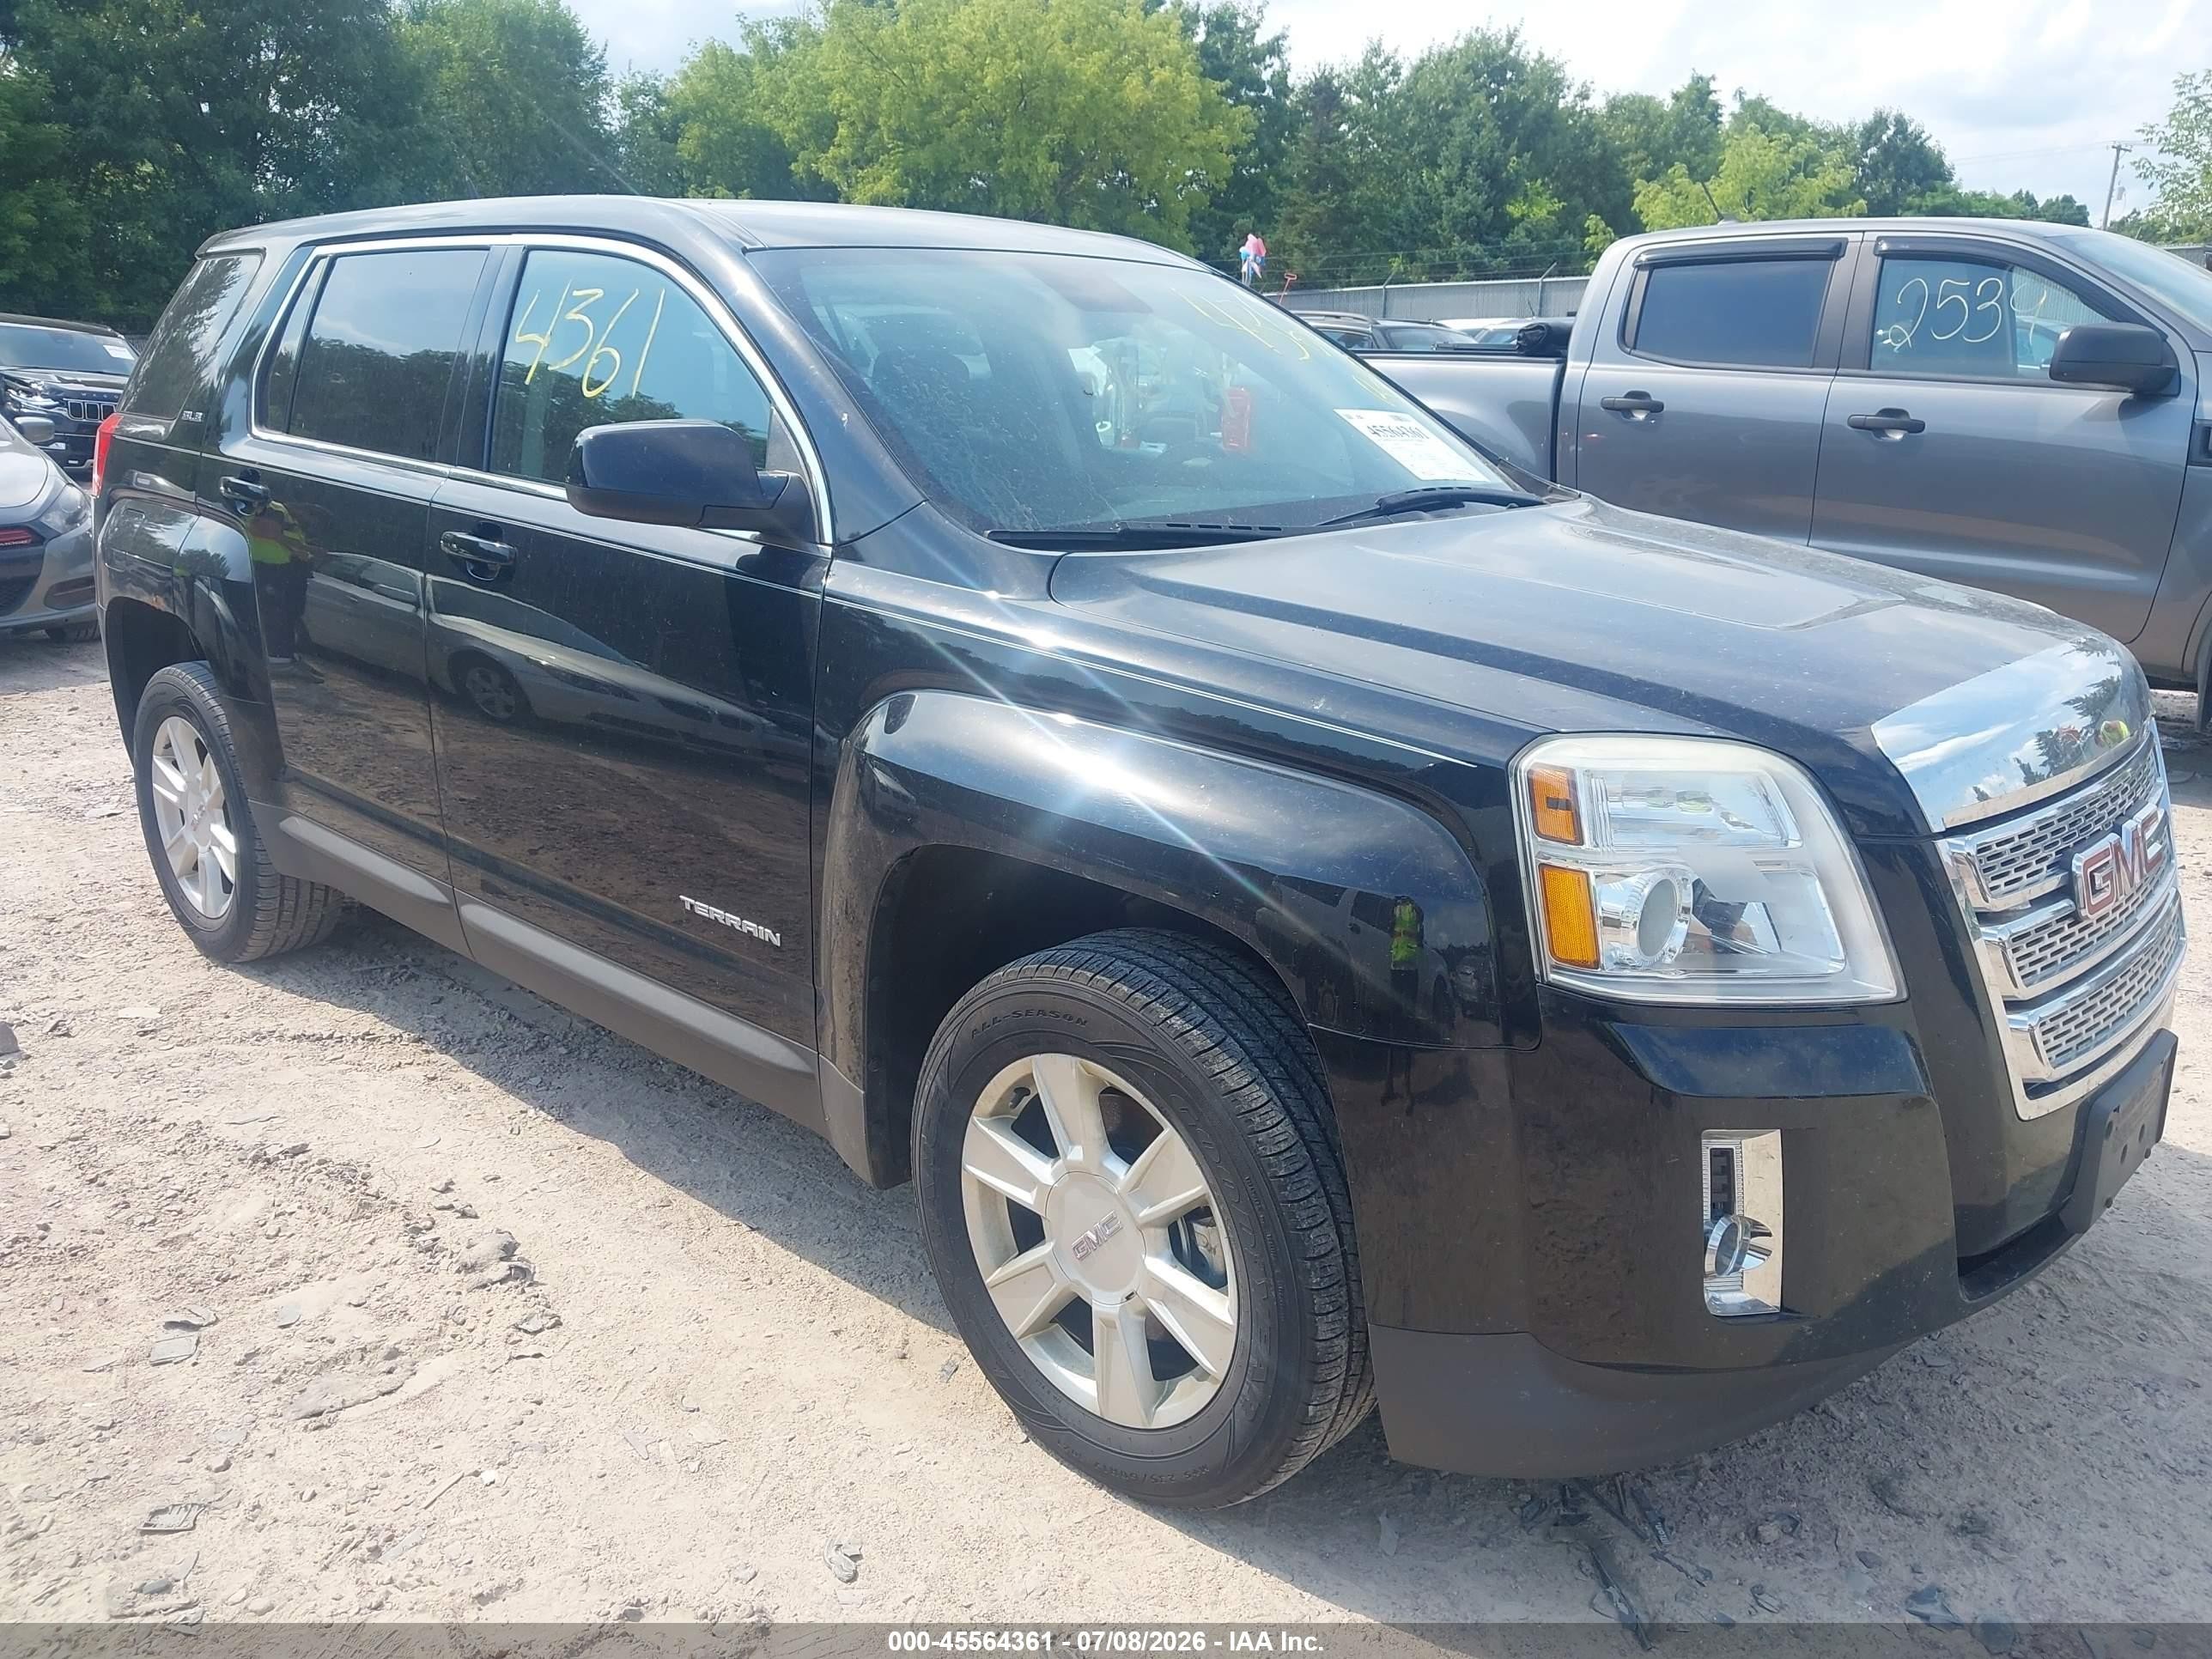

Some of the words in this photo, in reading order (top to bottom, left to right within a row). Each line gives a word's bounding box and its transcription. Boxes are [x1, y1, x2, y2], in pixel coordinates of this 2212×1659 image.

[515, 278, 666, 399] 4361
[1887, 276, 2048, 353] 2539
[2073, 803, 2165, 920] GMC
[679, 895, 781, 947] TERRAIN
[970, 1009, 1088, 1040] ALL-SEASON
[1071, 1209, 1124, 1261] GMC
